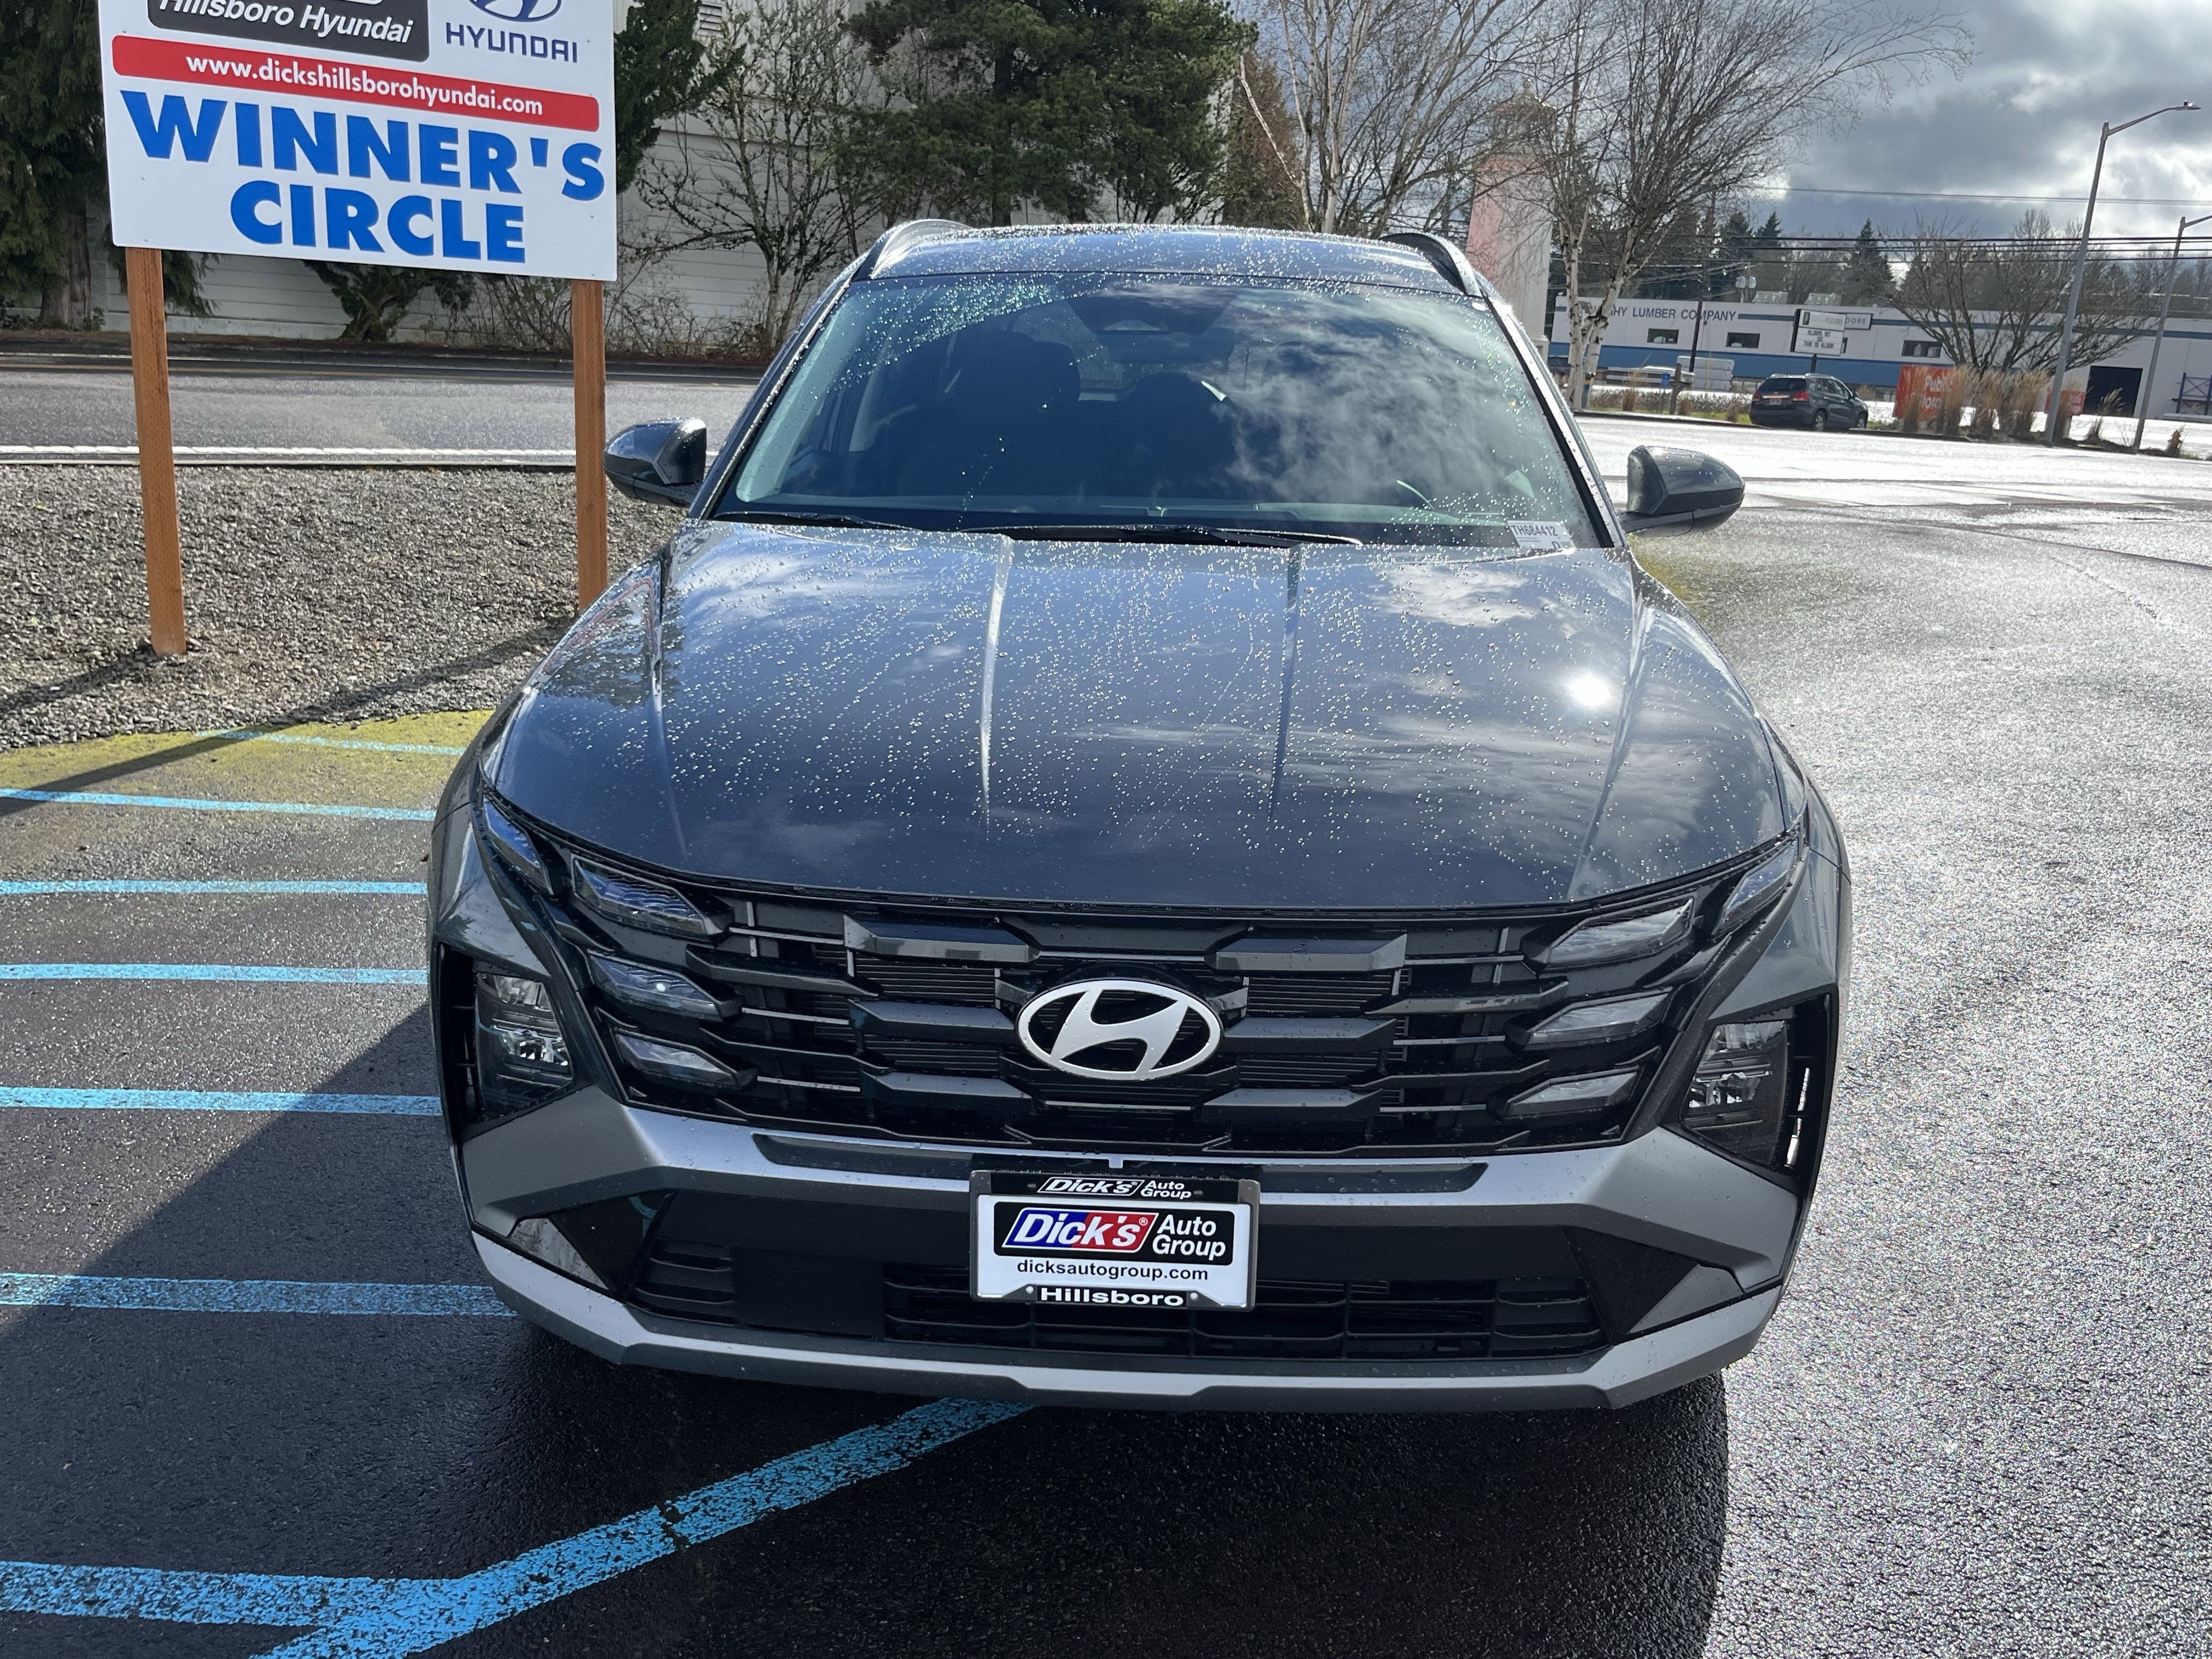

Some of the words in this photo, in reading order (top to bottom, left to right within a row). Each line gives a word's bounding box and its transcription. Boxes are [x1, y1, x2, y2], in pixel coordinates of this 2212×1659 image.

[300, 5, 414, 44] Hyundai
[445, 24, 578, 63] HYUNDAI
[186, 57, 543, 116] www.dickshillsborohyundai.com
[120, 90, 605, 201] WINNER'S
[230, 180, 526, 263] CIRCLE
[1633, 307, 1676, 319] LUMBER
[1681, 309, 1736, 321] COMPANY
[1511, 525, 1559, 537] TH684412
[1045, 1179, 1135, 1194] Dick's
[1144, 1180, 1185, 1190] Auto
[1140, 1188, 1192, 1200] Group
[1013, 1212, 1141, 1247] Dick's
[1156, 1215, 1217, 1236] Auto
[1153, 1236, 1226, 1260] Group
[1017, 1260, 1208, 1280] dicksautogroup.com
[1040, 1288, 1184, 1306] Hillsboro
